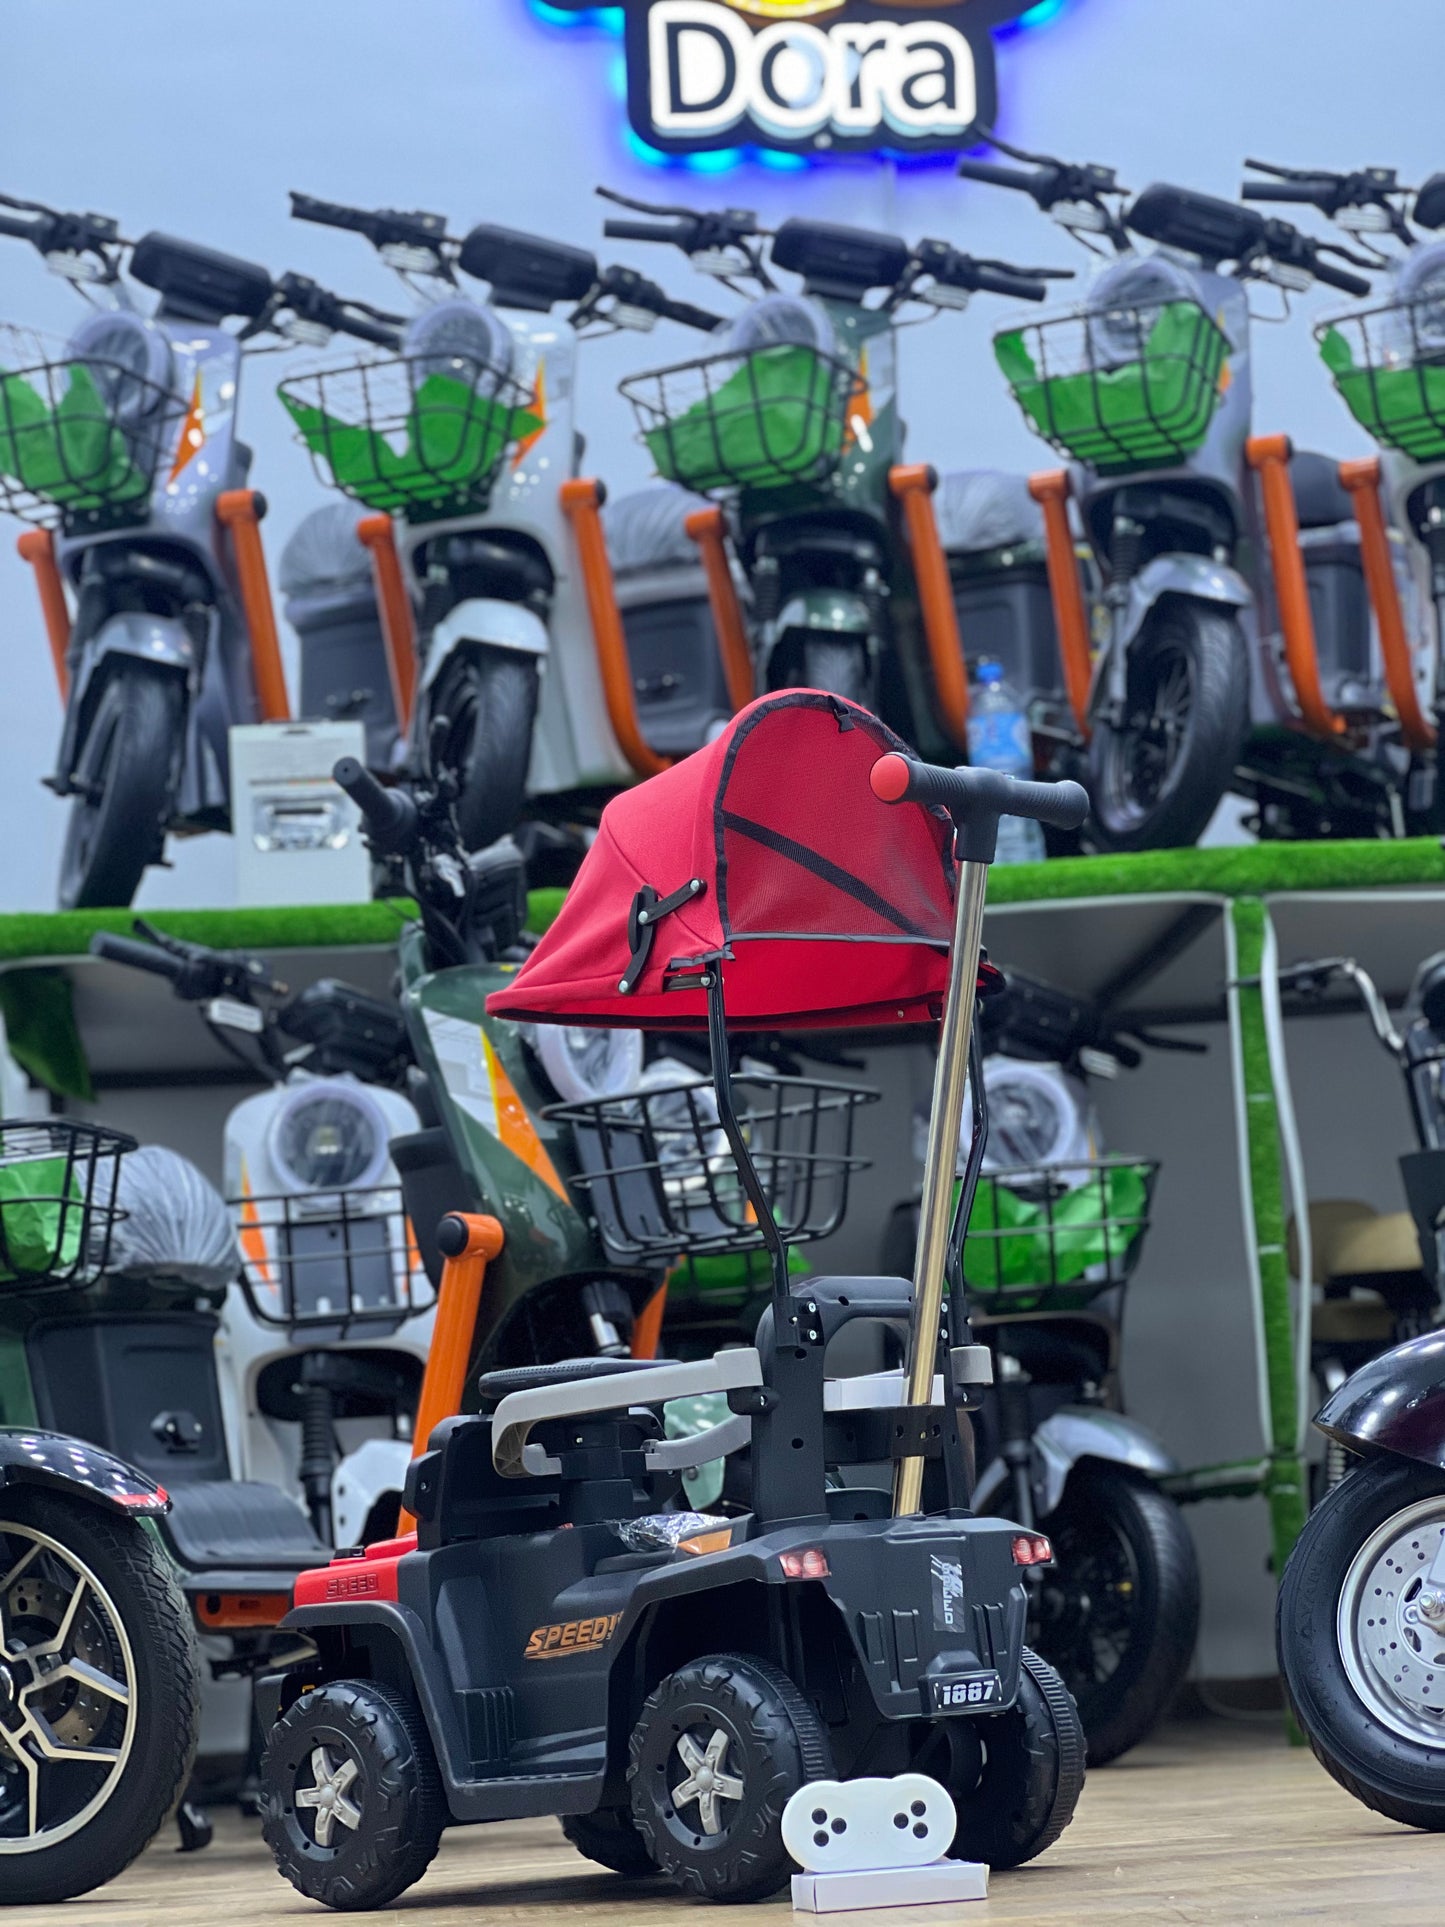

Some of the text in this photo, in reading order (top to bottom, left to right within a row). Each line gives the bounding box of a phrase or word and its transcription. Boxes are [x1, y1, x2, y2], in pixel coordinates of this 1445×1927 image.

[655, 12, 965, 122] Dora
[326, 1573, 378, 1597] SPEED
[942, 1680, 995, 1705] 1887
